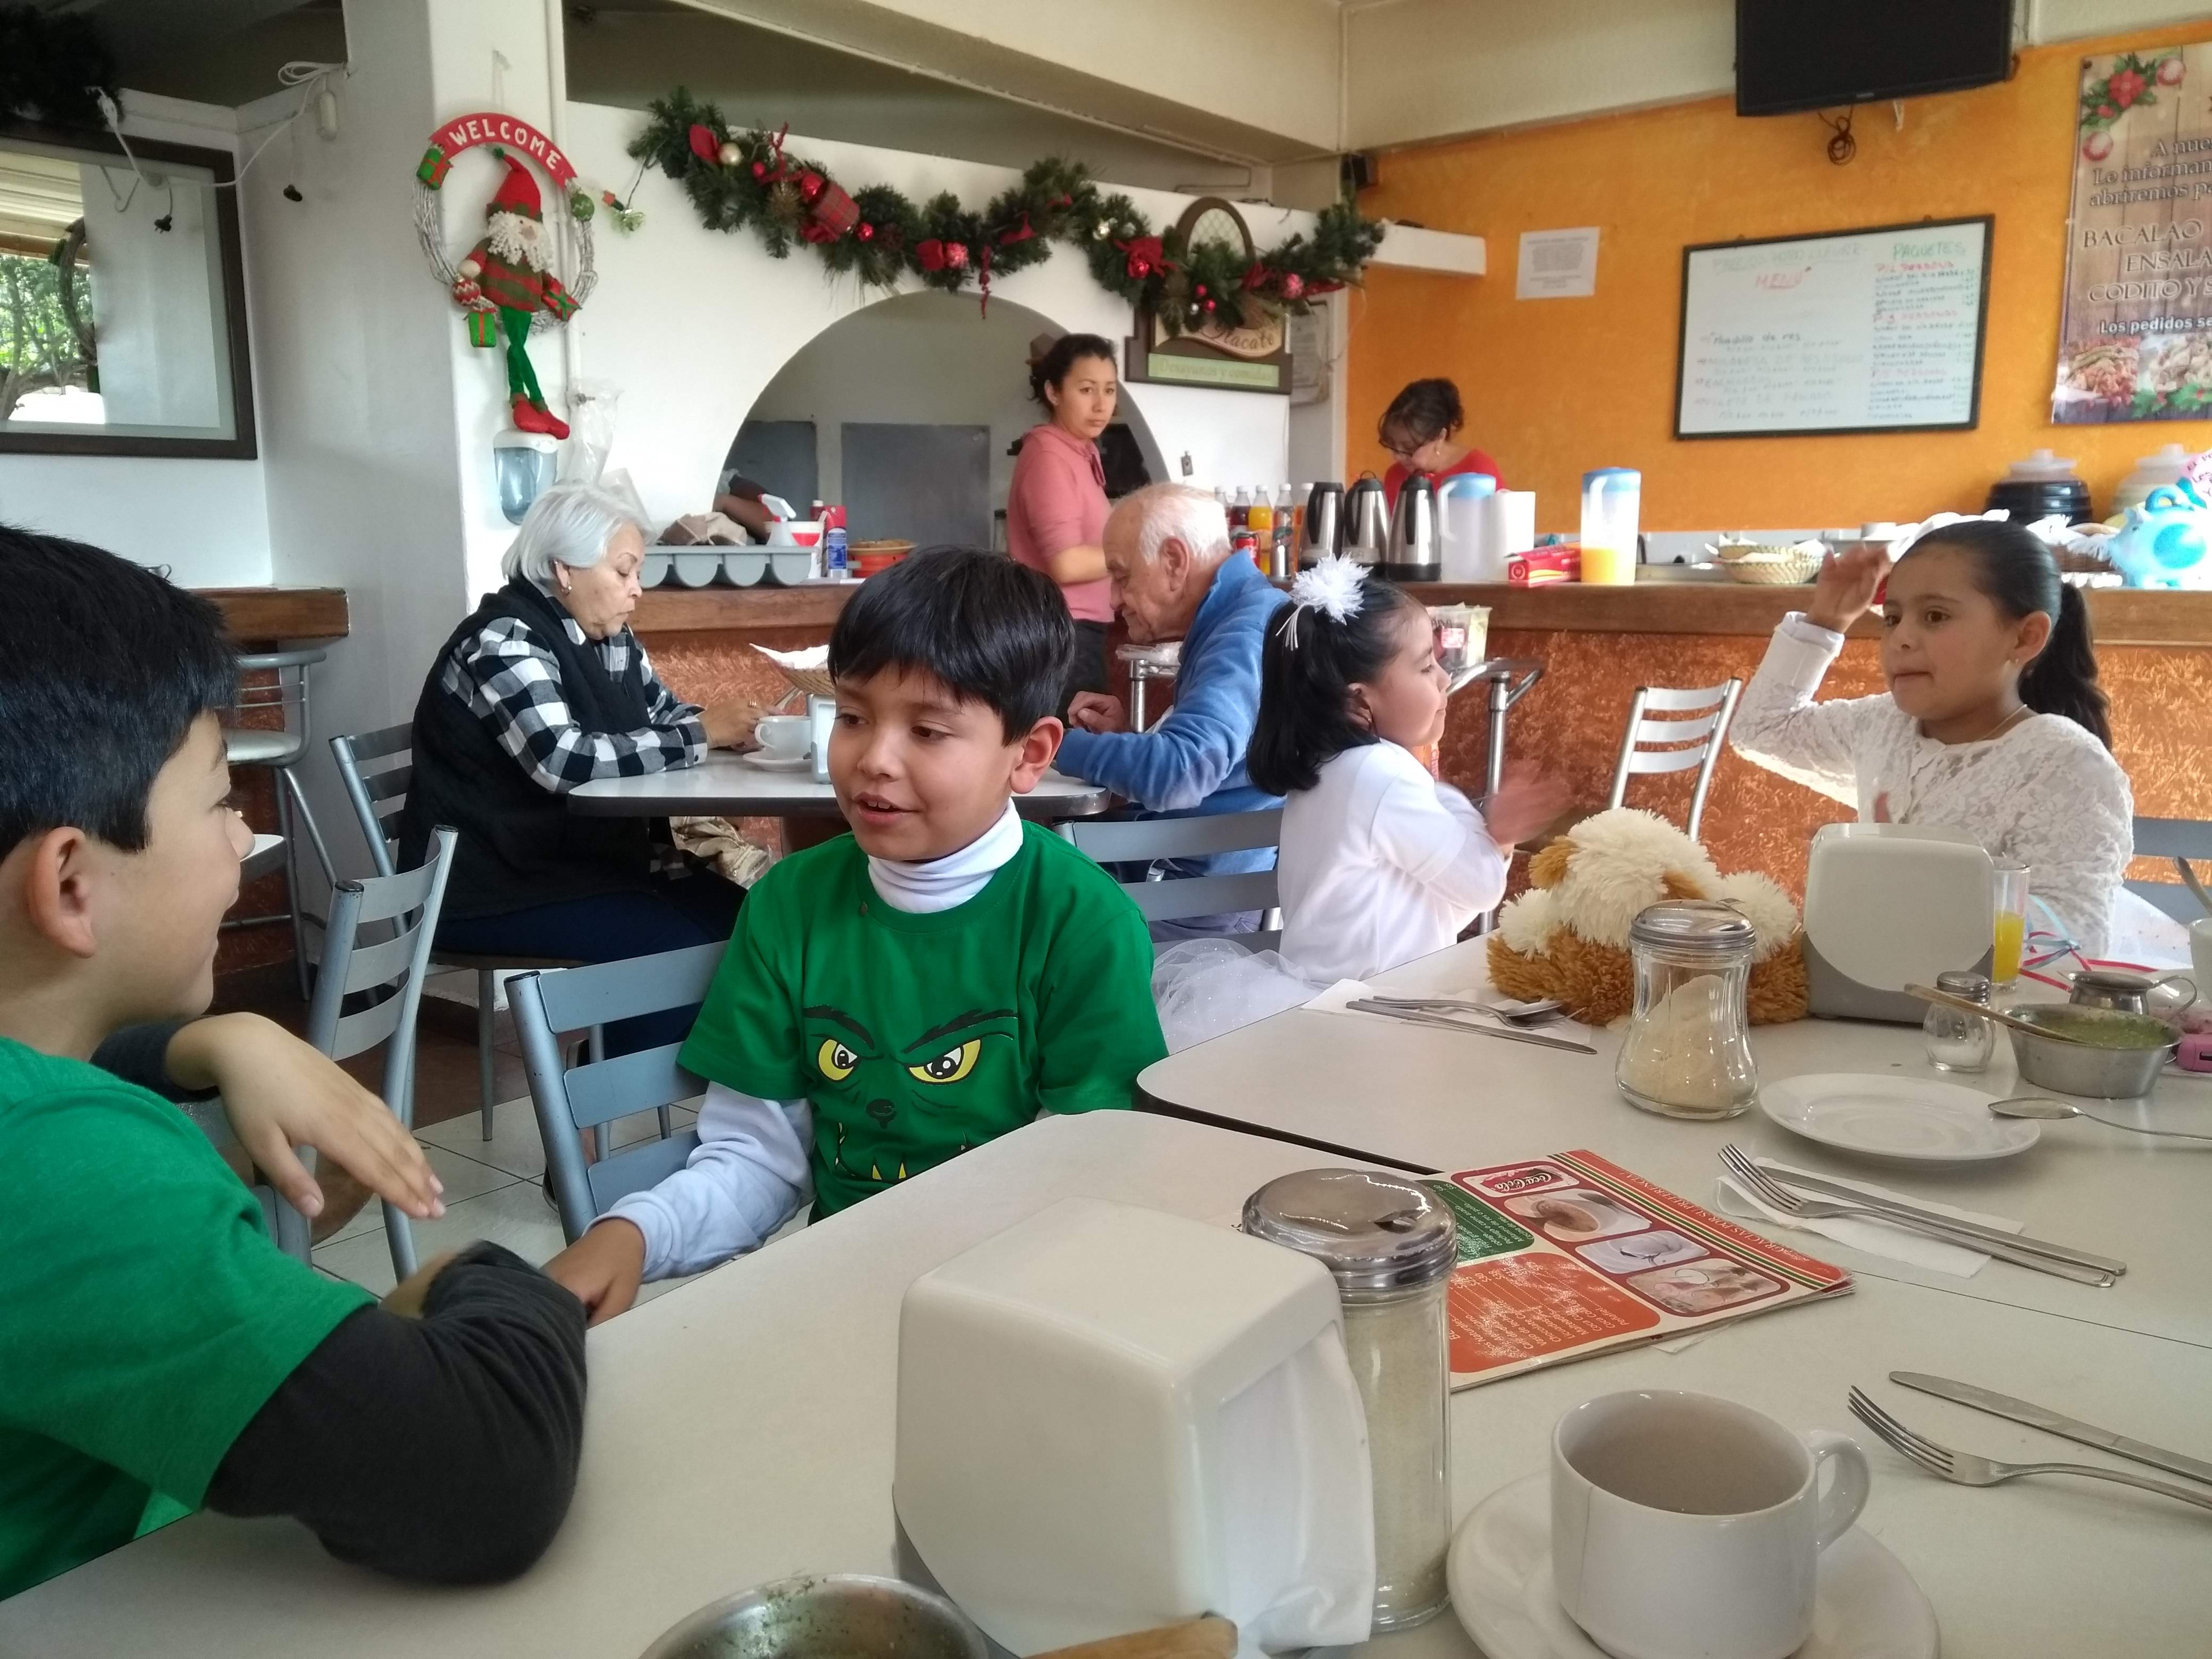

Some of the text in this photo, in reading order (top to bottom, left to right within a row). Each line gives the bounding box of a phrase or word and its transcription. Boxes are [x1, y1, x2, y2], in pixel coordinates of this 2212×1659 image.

[448, 118, 562, 170] WELCOME
[2150, 137, 2212, 157] A nue
[2090, 184, 2189, 206] abriremos
[2083, 219, 2203, 248] BACALAO
[2088, 278, 2182, 303] CODITO
[2184, 276, 2203, 296] Y
[2099, 319, 2126, 334] Los
[2130, 315, 2193, 336] pedidos
[1690, 1208, 1711, 1217] SU
[1706, 1216, 1735, 1228] POR
[1728, 1227, 1787, 1253] GRACIAS
[1472, 1272, 1576, 1339] Licuados $30
[1448, 1318, 1487, 1342] Naturales
[1495, 1314, 1521, 1327] leche
[1521, 1318, 1563, 1343] Chocolate
[1546, 1311, 1590, 1335] Malteadas
[1580, 1320, 1604, 1331] Coca
[1593, 1317, 1617, 1328] Coca
[1525, 1333, 1548, 1346] Vaso
